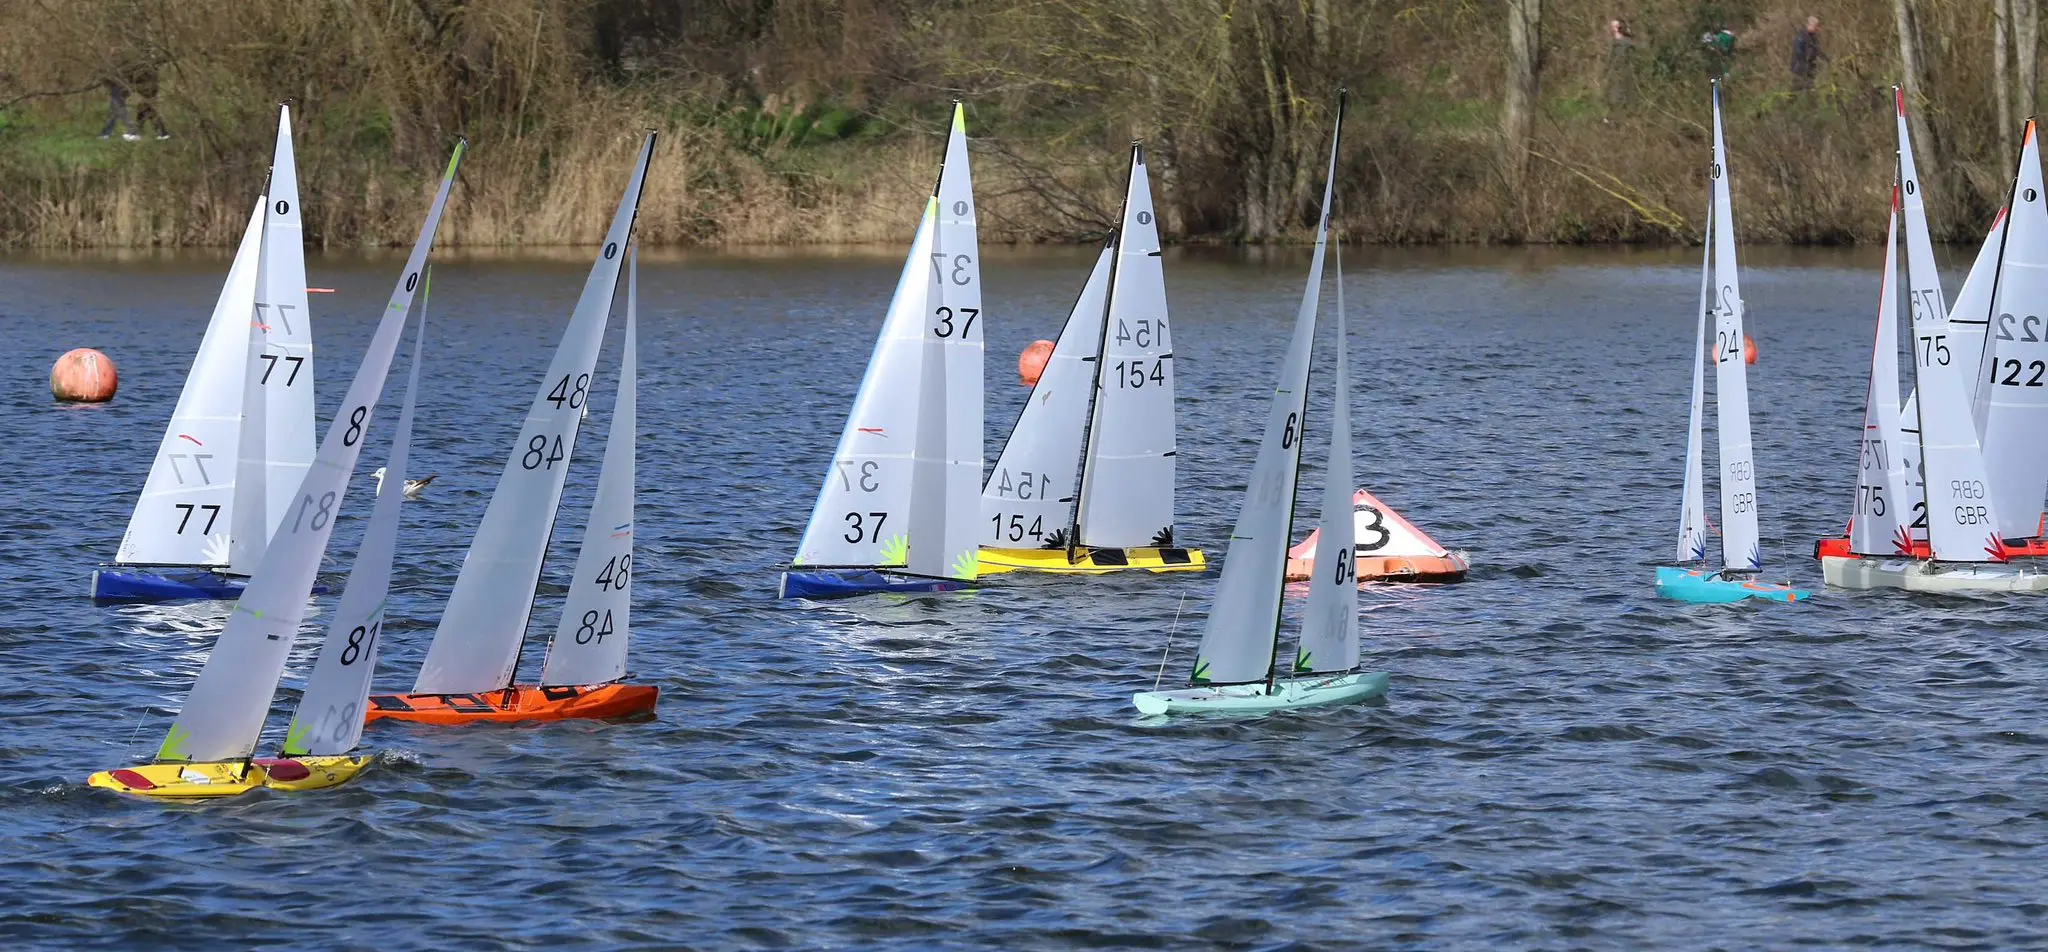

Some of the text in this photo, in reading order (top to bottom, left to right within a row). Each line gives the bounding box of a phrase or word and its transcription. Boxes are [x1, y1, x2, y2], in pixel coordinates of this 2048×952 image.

[934, 306, 979, 340] 37
[1718, 328, 1739, 363] 24
[1916, 334, 1951, 368] 175
[260, 354, 303, 387] 77
[1115, 359, 1165, 389] 154
[1990, 357, 2046, 387] 122
[547, 373, 589, 410] 48
[1732, 492, 1754, 514] GBR
[1857, 485, 1886, 517] 175
[1954, 505, 1989, 525] GBR
[176, 504, 220, 536] 77
[844, 512, 888, 544] 37
[992, 512, 1043, 542] 154
[1354, 503, 1391, 551] 3
[595, 554, 631, 592] 48
[1335, 546, 1356, 586] 64
[340, 621, 379, 666] 81
